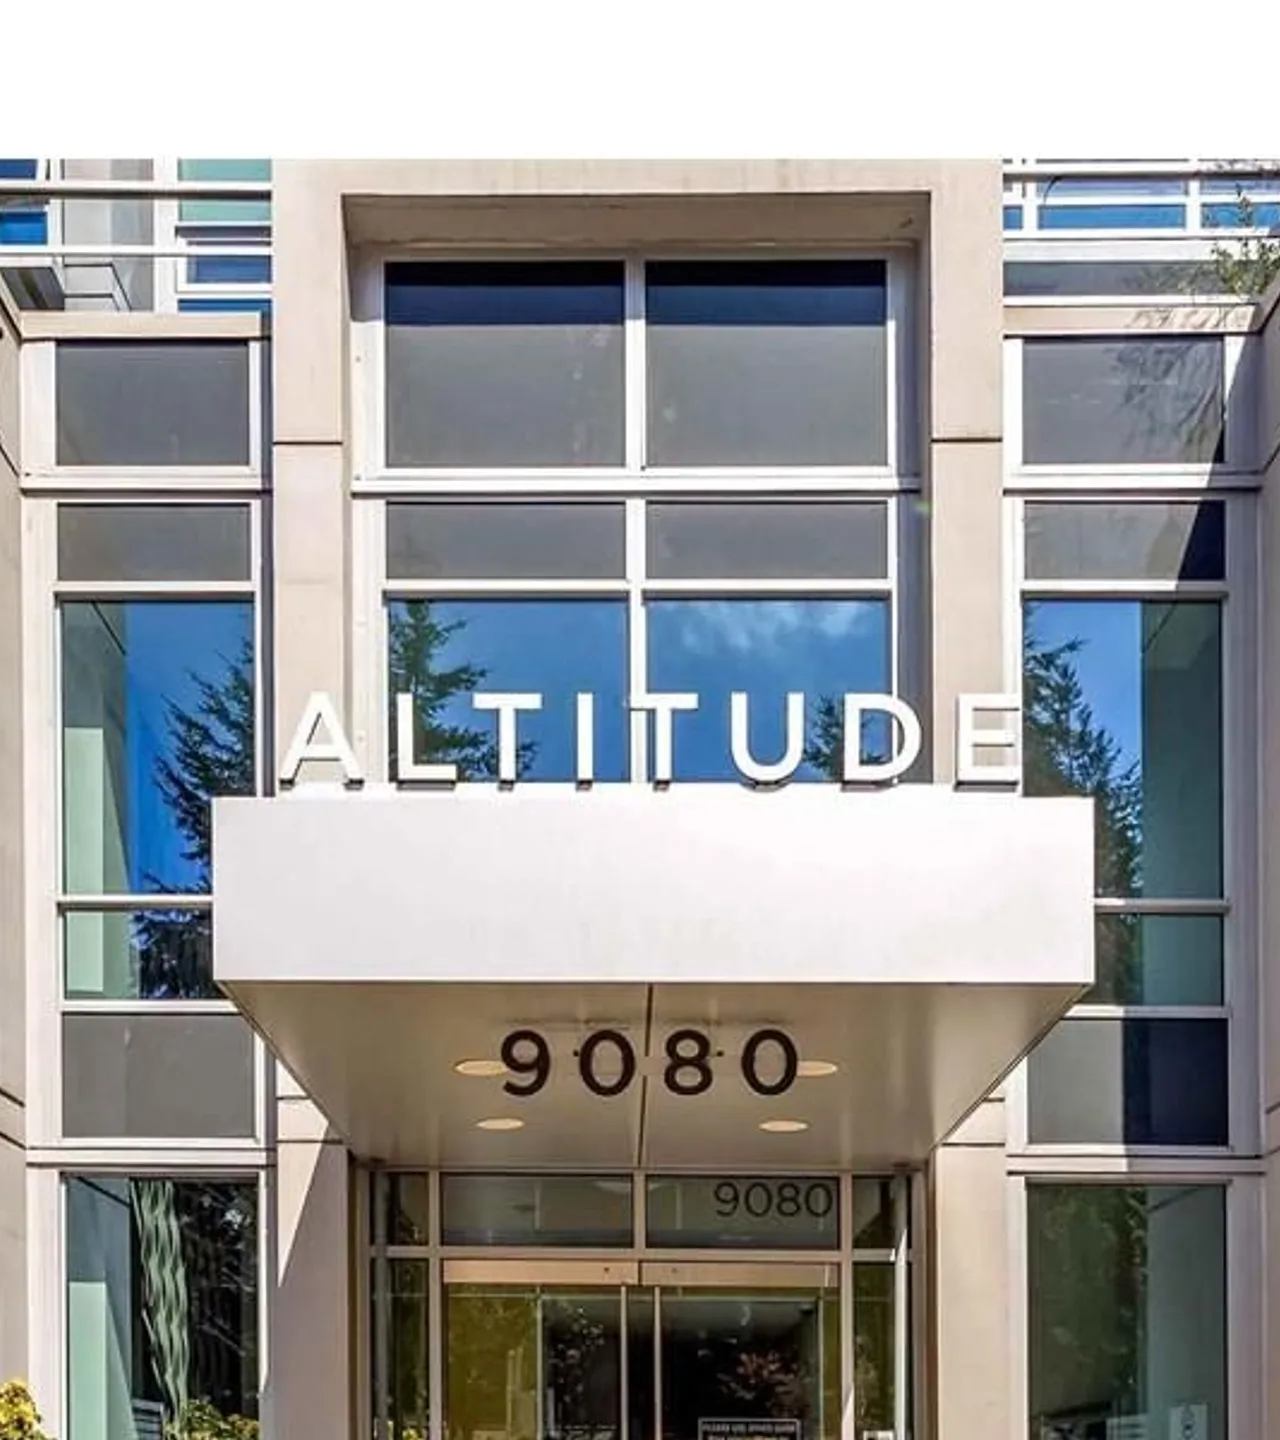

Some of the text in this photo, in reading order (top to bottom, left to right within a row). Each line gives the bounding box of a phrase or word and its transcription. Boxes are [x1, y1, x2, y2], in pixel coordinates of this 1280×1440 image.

[278, 691, 1022, 788] ALTITUDE
[500, 1028, 799, 1097] 9080
[714, 1181, 834, 1218] 9080
